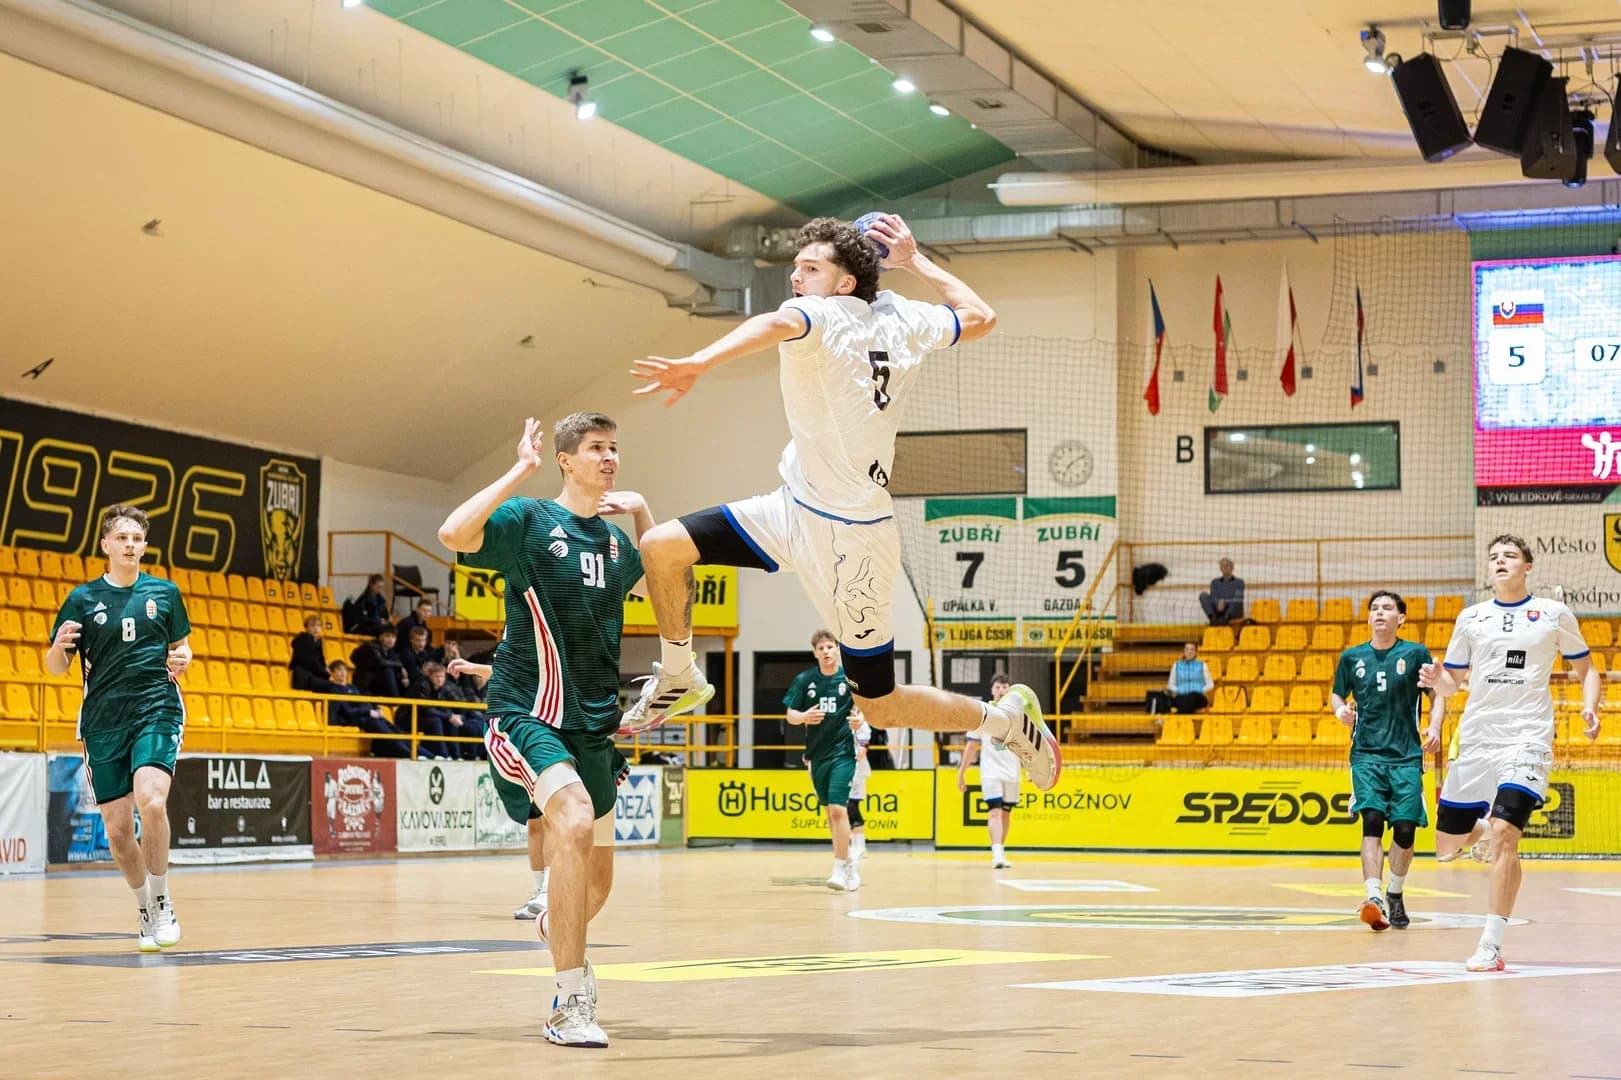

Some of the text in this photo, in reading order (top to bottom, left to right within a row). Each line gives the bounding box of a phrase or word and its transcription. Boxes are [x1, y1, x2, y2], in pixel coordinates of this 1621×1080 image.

[1508, 346, 1525, 367] 5
[868, 350, 891, 411] 5
[1176, 435, 1194, 463] B
[0, 429, 246, 573] 1926
[939, 523, 1003, 544] ZUBŘÍ
[1037, 521, 1102, 543] ZUBŘÍ
[1537, 535, 1597, 555] Město
[580, 552, 605, 589] 91
[956, 552, 984, 588] 7
[1055, 550, 1086, 588] 5
[122, 617, 136, 642] 8
[960, 629, 983, 641] LIGA
[985, 626, 1013, 641] ČSSR
[1376, 671, 1387, 692] 5
[820, 697, 837, 713] 66
[208, 759, 272, 789] HALA
[208, 794, 272, 809] bar a restaurace
[615, 795, 654, 819] DEZA
[751, 787, 898, 816] Husqna
[1044, 789, 1131, 809] ROŽNOV
[1176, 792, 1359, 825] SPEDOS
